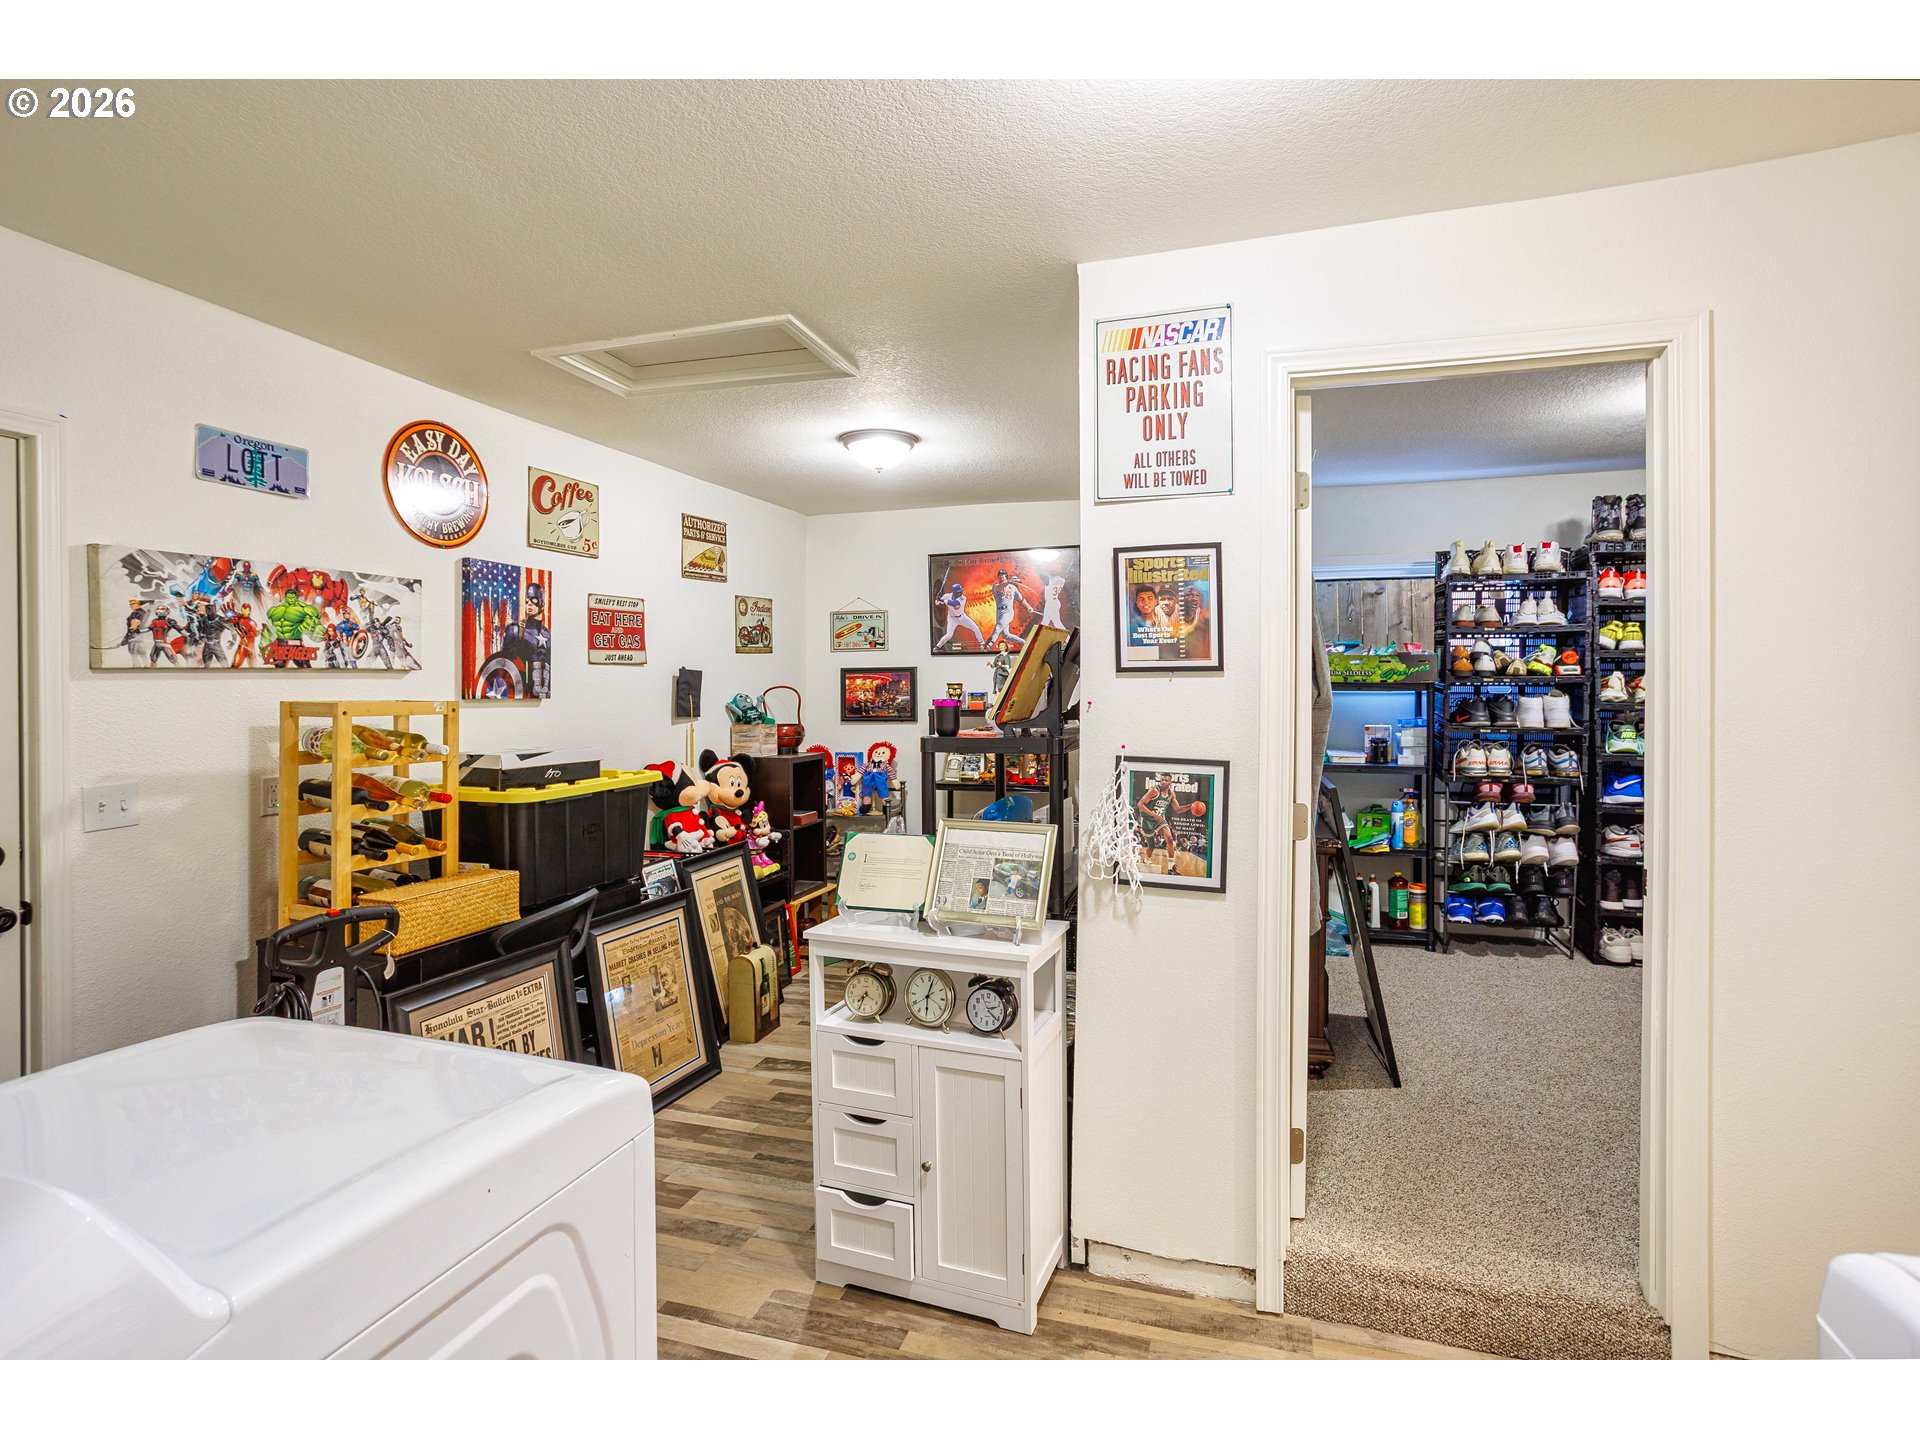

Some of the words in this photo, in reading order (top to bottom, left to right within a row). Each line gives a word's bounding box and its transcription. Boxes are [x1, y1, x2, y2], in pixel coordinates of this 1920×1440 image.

[1139, 317, 1226, 349] NASCAR
[1106, 353, 1171, 385] RACING
[1179, 347, 1224, 378] FANS
[1126, 380, 1204, 413] PARKING
[1143, 412, 1188, 441] ONLY
[234, 435, 275, 452] Oregon
[399, 430, 445, 463] EASY
[447, 438, 479, 476] DAY
[227, 443, 282, 481] LOTT
[1134, 452, 1152, 469] ALL
[1156, 450, 1196, 467] OTHERS
[1123, 473, 1150, 489] WILL
[1153, 472, 1167, 488] BE
[1170, 469, 1207, 487] TOWED
[532, 475, 594, 515] Coffee
[442, 509, 474, 533] BREWING
[683, 516, 726, 534] AUTHORIZED
[533, 538, 566, 548] BOTTOMLESS
[683, 528, 700, 539] PARTS
[701, 531, 705, 539] &
[706, 532, 726, 543] SERVICE
[1133, 556, 1186, 571] Sports
[1128, 566, 1209, 583] Illustrated
[594, 598, 615, 606] SMILEY'S
[750, 601, 771, 613] Indian
[591, 611, 611, 626] EAT
[615, 613, 642, 628] HERE
[594, 633, 615, 648] GET
[618, 634, 641, 648] GAS
[262, 640, 320, 665] AVENGERS
[618, 654, 633, 662] AHEAD
[1379, 663, 1431, 680] Grapes
[1621, 731, 1637, 739] NIKE
[1155, 772, 1189, 783] Sorts
[608, 959, 627, 971] MARKET
[628, 952, 647, 964] CRASHES
[647, 949, 652, 957] IN
[652, 943, 668, 955] SELLING
[668, 938, 680, 947] PANIC
[425, 1014, 464, 1036] Honolulu
[466, 993, 516, 1018] Star-Bulletin
[522, 981, 543, 996] EXTRA
[522, 1030, 535, 1054] BY
[631, 1029, 667, 1050] Depression
[667, 1020, 684, 1032] Years
